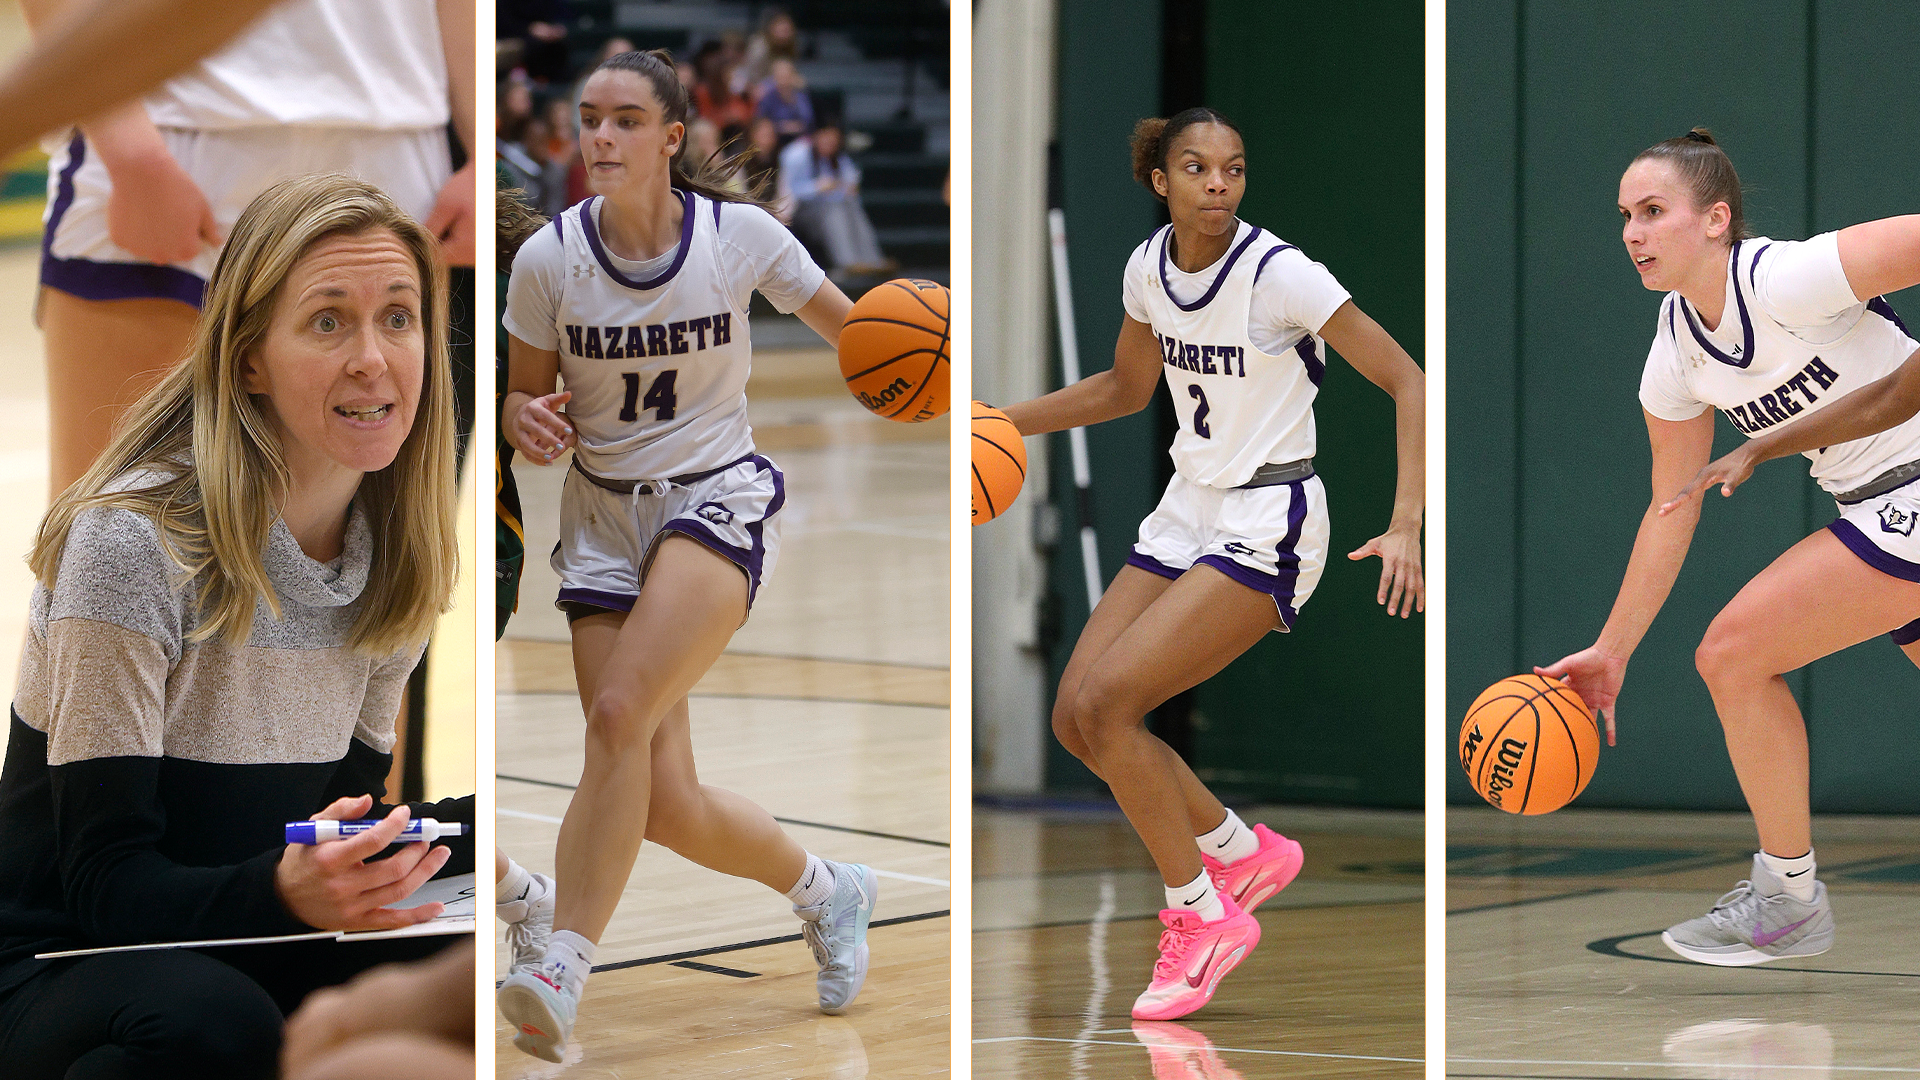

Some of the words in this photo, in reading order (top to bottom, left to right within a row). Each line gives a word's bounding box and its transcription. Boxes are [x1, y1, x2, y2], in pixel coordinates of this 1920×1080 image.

[565, 312, 732, 360] NAZARETH
[1155, 329, 1246, 378] AZARET
[619, 369, 678, 422] 14
[1188, 384, 1211, 440] 2
[1721, 355, 1840, 434] AZARETH
